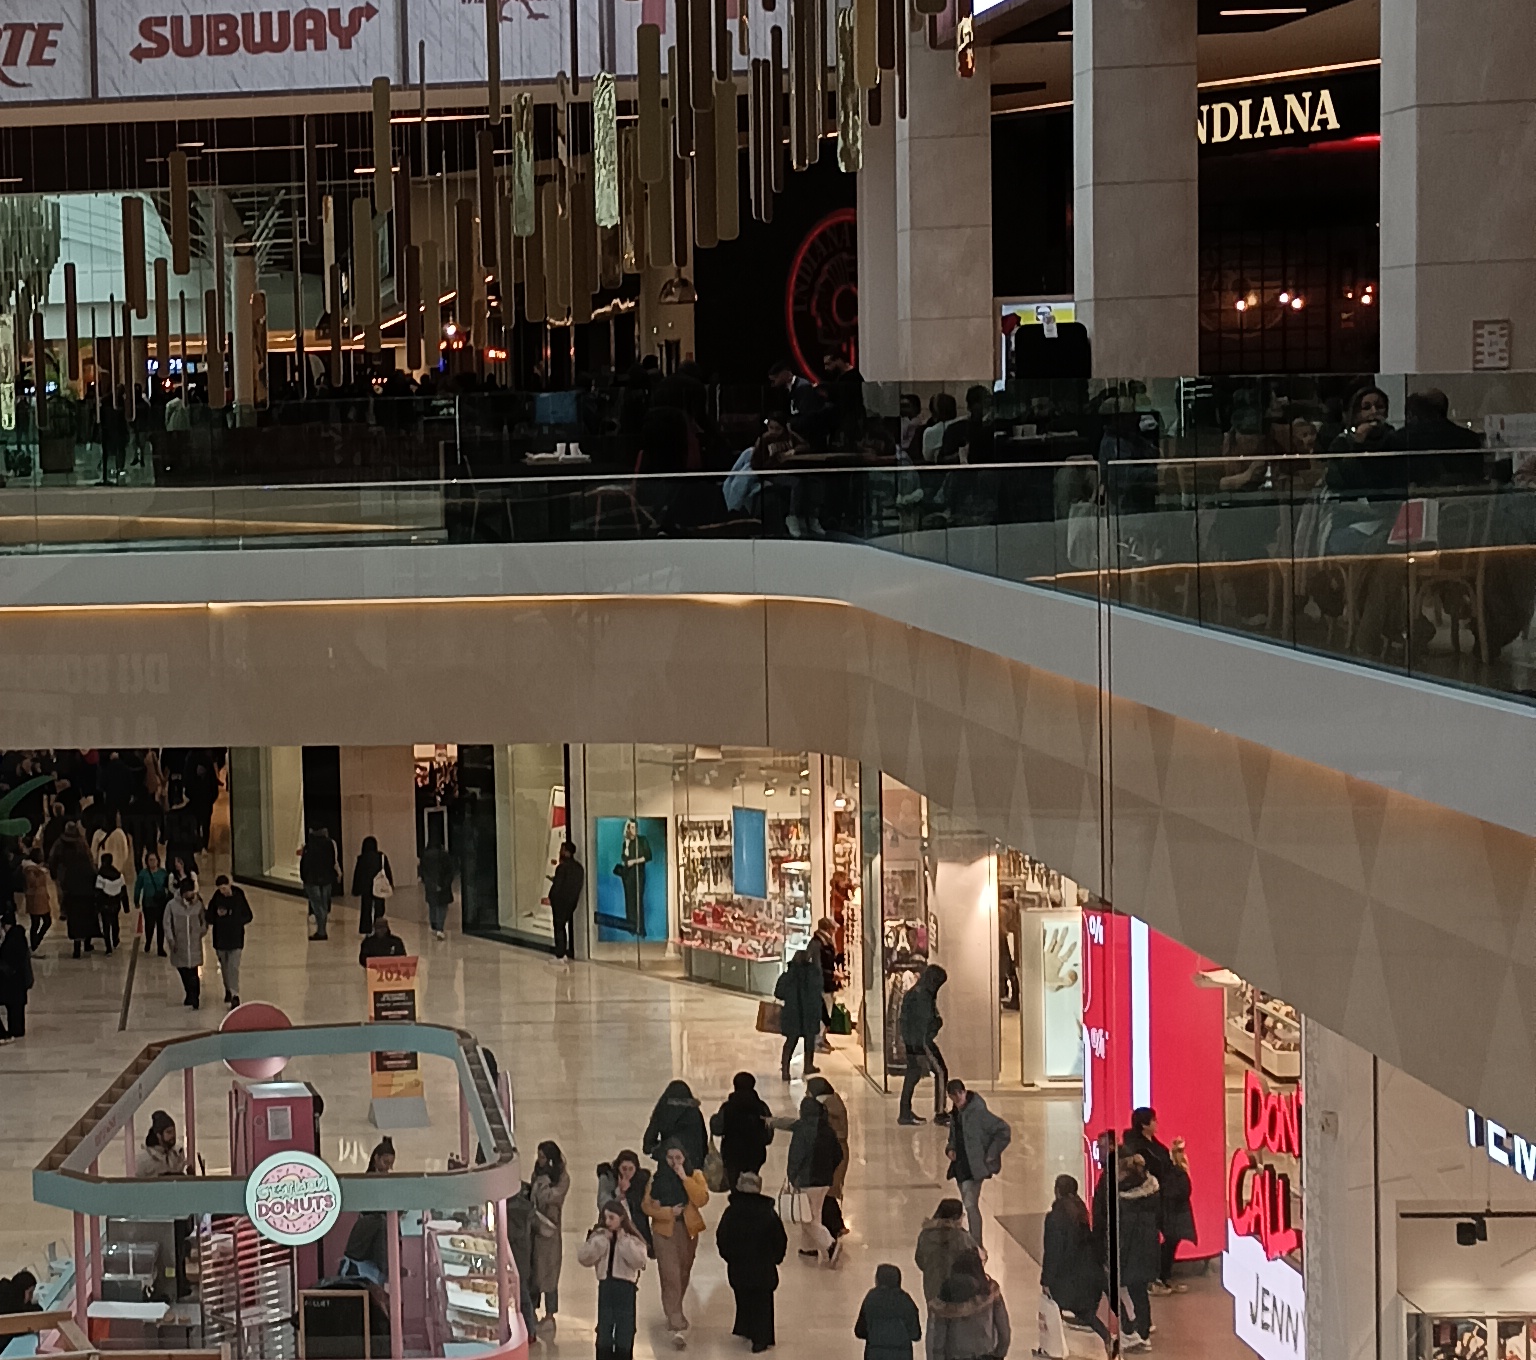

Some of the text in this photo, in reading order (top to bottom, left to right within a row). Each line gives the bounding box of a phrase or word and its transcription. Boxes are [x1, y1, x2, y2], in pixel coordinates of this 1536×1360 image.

[129, 1, 379, 64] SUBWAY
[1197, 89, 1341, 145] DIANA
[1244, 1069, 1303, 1158] DON'
[257, 1194, 334, 1218] DONUTS
[1230, 1148, 1302, 1262] CALL
[1249, 1272, 1307, 1354] JENN
